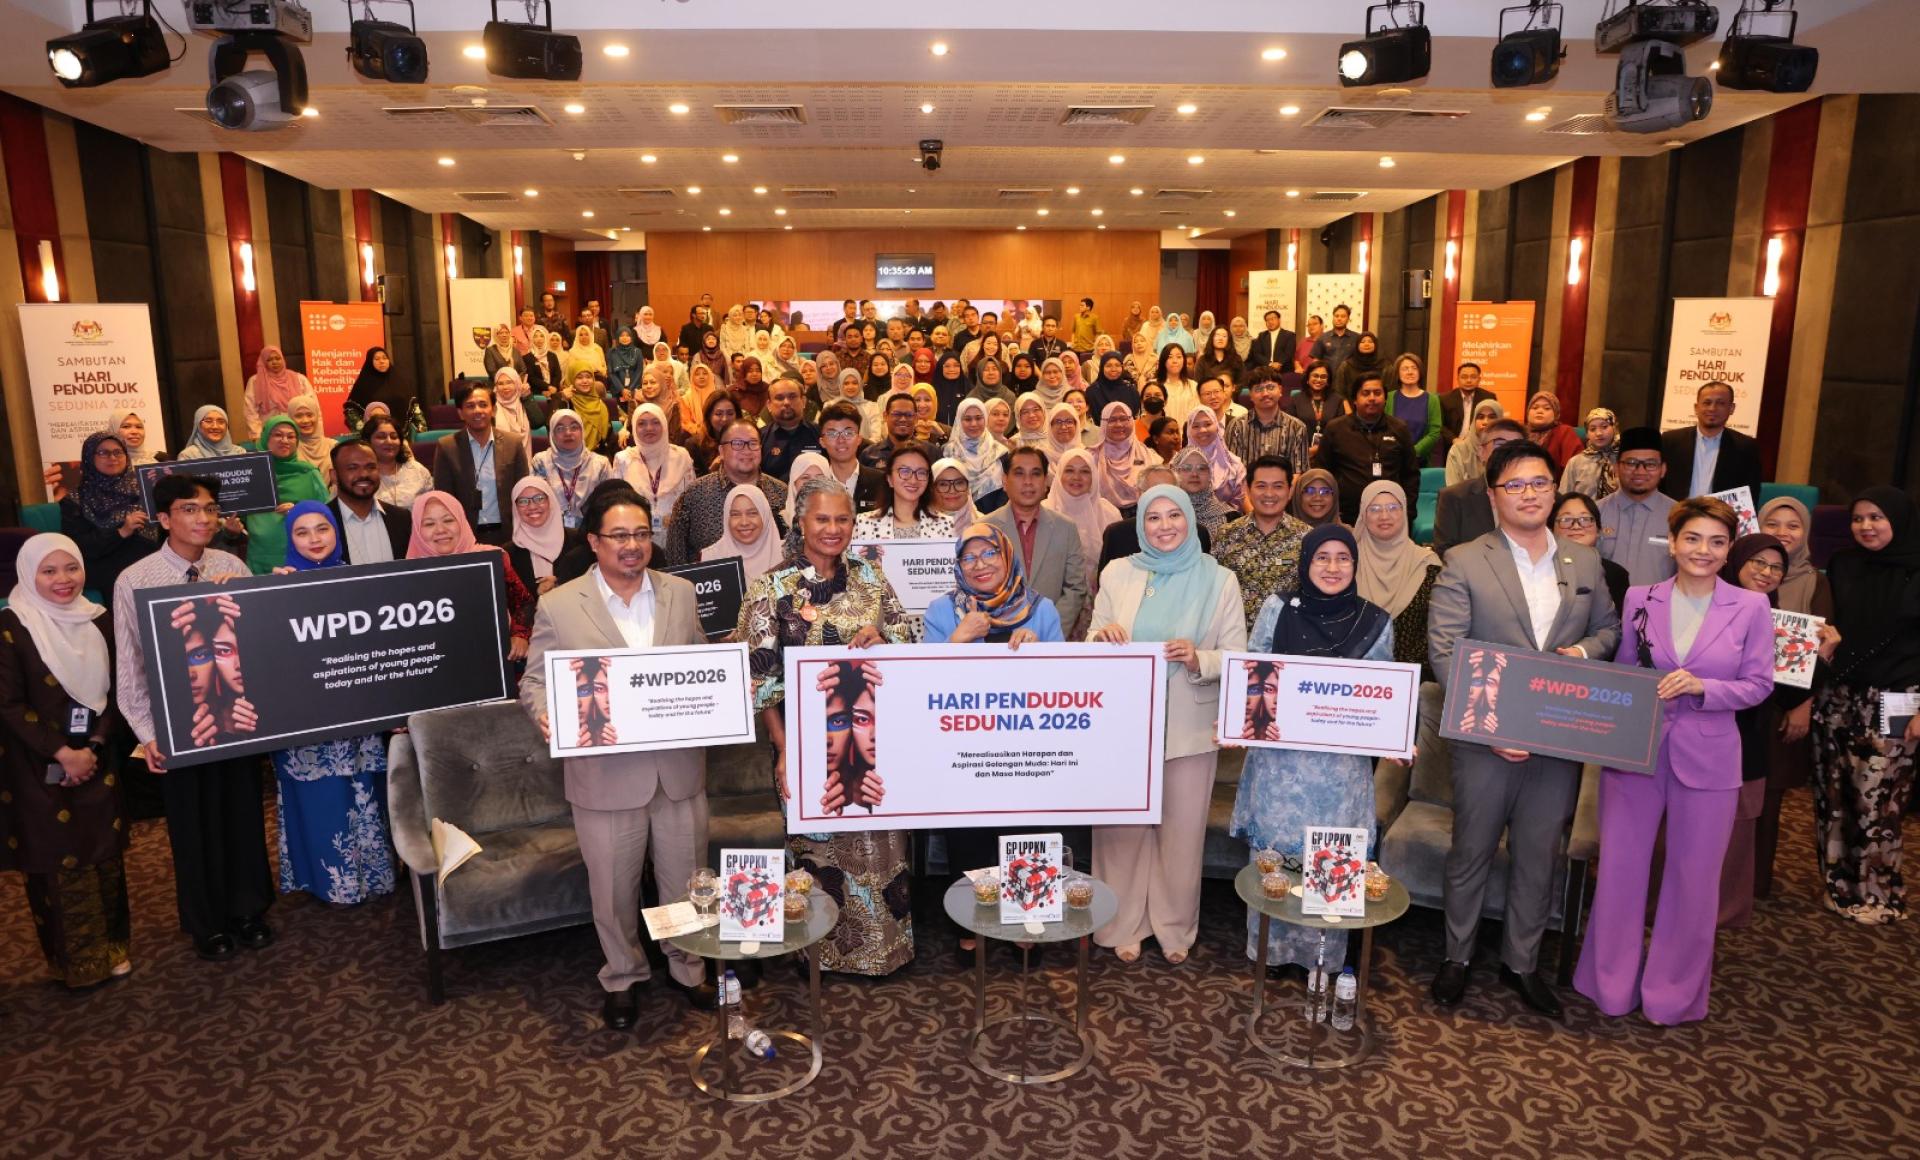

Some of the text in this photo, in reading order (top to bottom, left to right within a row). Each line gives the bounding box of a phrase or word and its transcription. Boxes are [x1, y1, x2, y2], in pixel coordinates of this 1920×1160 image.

[878, 266, 933, 275] 10:35:26 AM
[1462, 341, 1512, 350] Melahirkan
[312, 349, 362, 360] Menjamin
[1488, 349, 1498, 357] di
[1690, 347, 1742, 357] SAMBUTAN
[57, 356, 126, 366] SAMBUTAN
[1698, 360, 1726, 370] HARI
[74, 372, 111, 383] HARI
[314, 376, 356, 385] Memilih
[1680, 370, 1744, 382] PENDUDUK
[53, 382, 138, 396] PENDUDUK
[314, 386, 344, 394] Untuk
[1673, 386, 1698, 395] SEDU
[48, 400, 146, 412] SEDUNIA 2026
[231, 476, 250, 484] 2026
[902, 558, 956, 567] HARI PENDU
[907, 567, 946, 576] SEDUNIA
[696, 578, 722, 594] 026
[289, 598, 456, 642] WPD 2026
[321, 642, 436, 664] "Realising the hopes and
[313, 664, 366, 679] aspirations
[368, 662, 379, 670] of
[380, 658, 408, 670] young
[324, 679, 352, 690] today
[354, 676, 372, 684] and
[374, 673, 388, 682] for
[390, 670, 404, 679] the
[630, 668, 726, 688] #WPD2026
[1298, 680, 1393, 700] #WPD2026
[1529, 677, 1633, 706] #WPD2026
[928, 691, 1104, 710] HARI PENDUDUK
[940, 712, 1091, 732] SEDUNIA 2026
[1022, 750, 1056, 760] Harapan
[952, 761, 984, 770] Aspirasi
[985, 760, 1023, 770] Golongan
[1312, 832, 1351, 846] GP LPPKN
[1006, 841, 1046, 854] GP LPPKN
[726, 854, 768, 869] GP LPPKN
